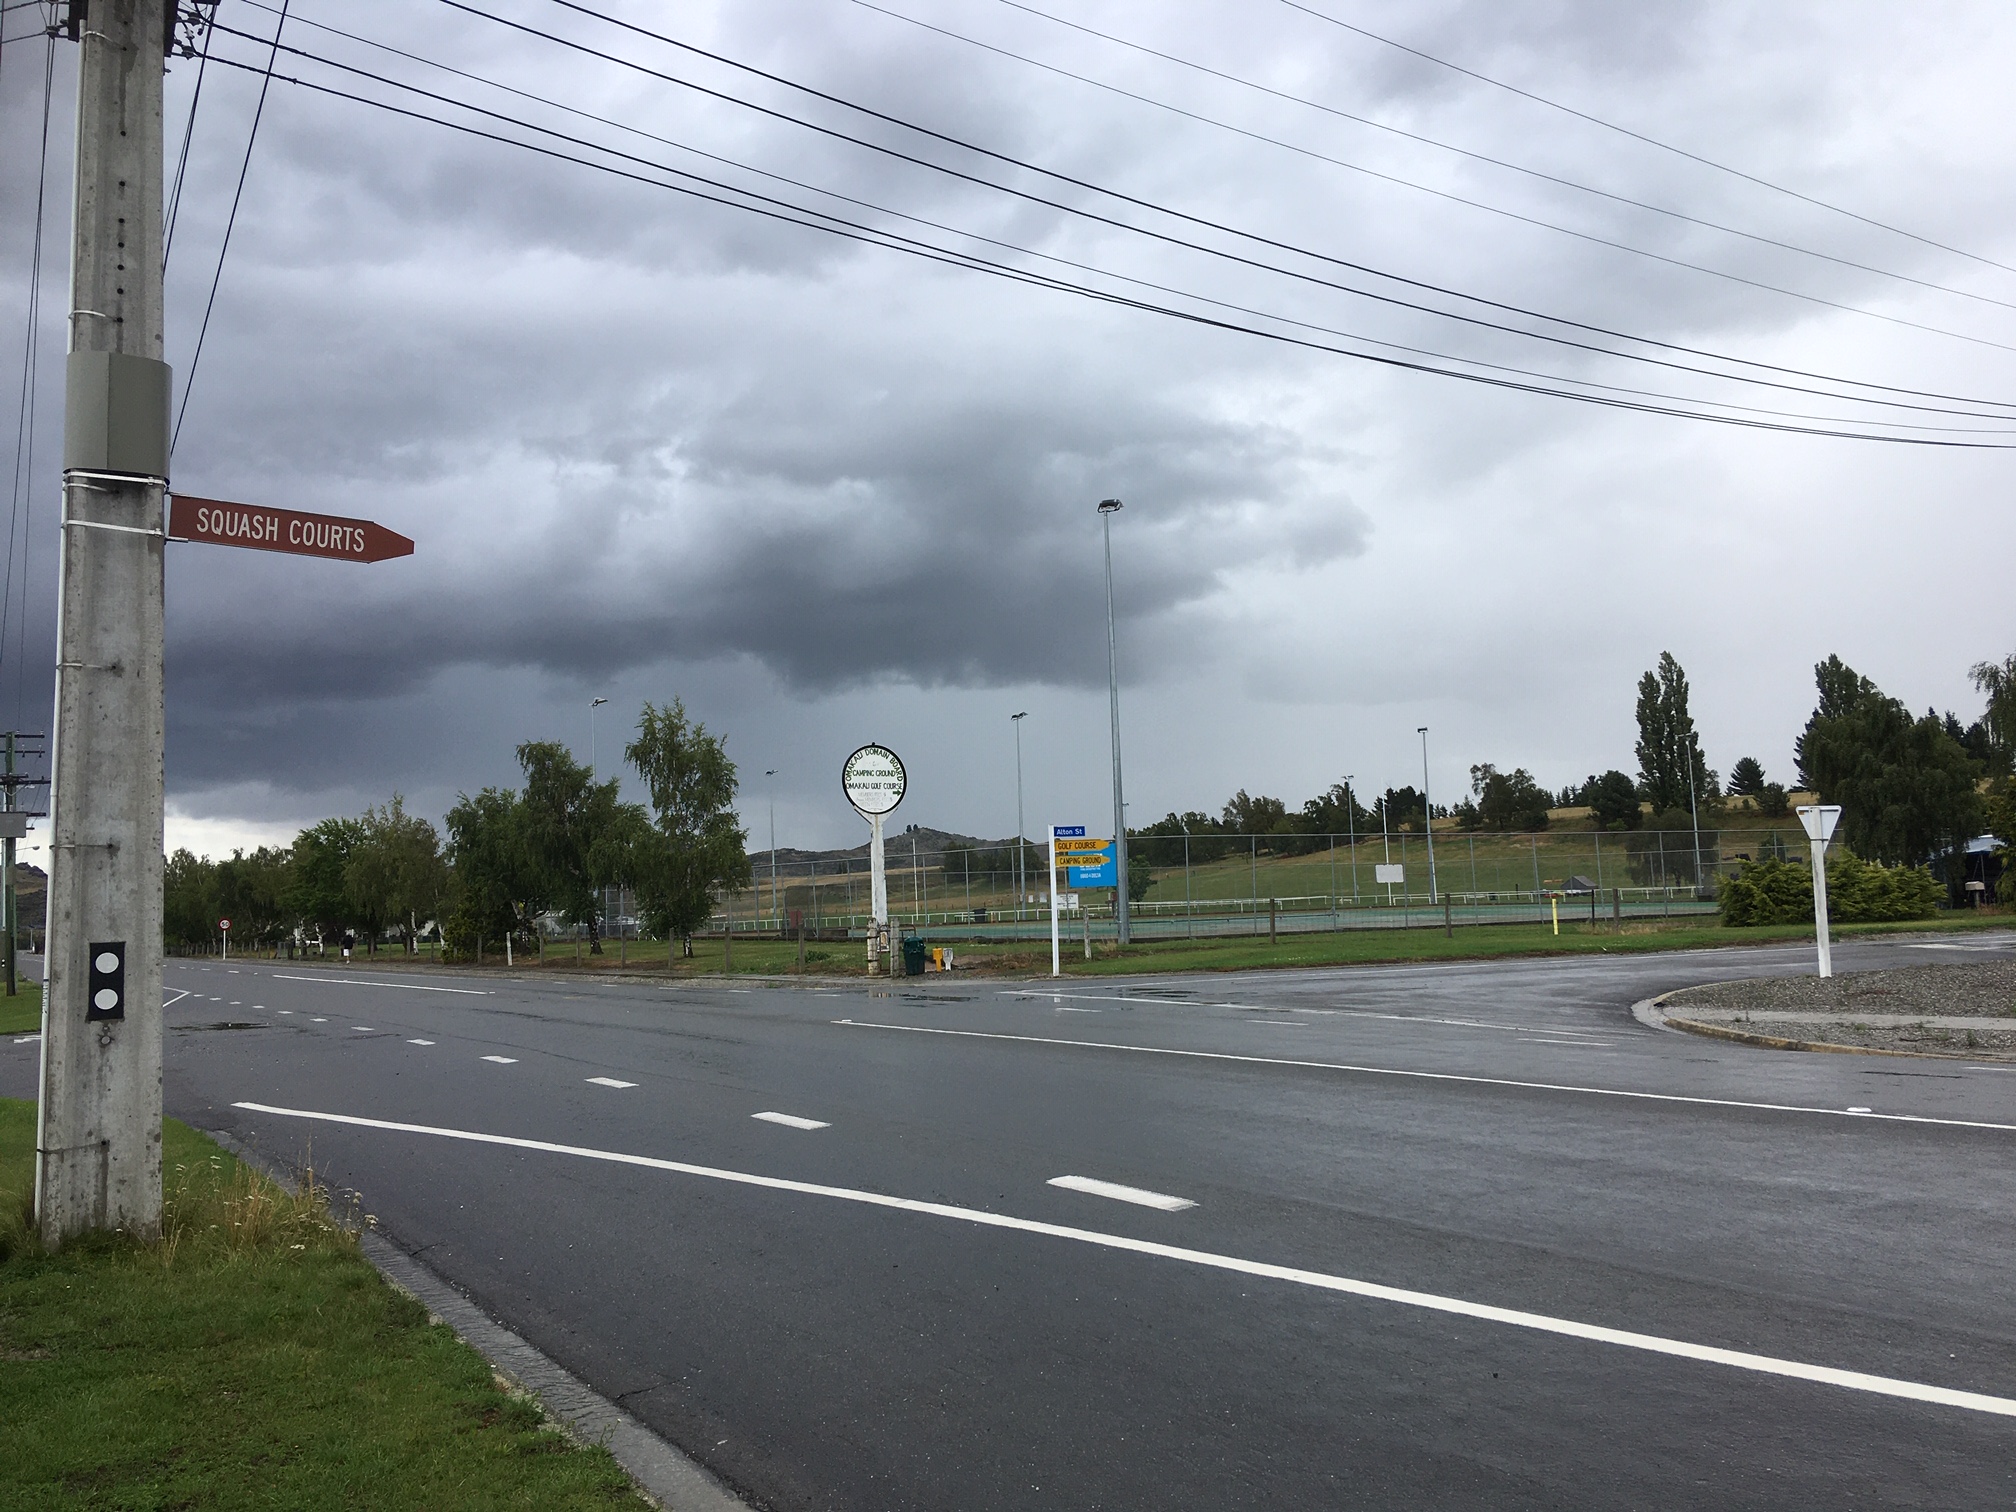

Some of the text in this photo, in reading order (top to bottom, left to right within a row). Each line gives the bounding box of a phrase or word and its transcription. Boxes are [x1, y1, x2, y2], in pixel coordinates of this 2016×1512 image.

[197, 507, 365, 553] SQUASH COURTS
[845, 748, 904, 782] OMAKAU DOMAIN BOARD
[846, 782, 903, 790] OMAKAU GOLF COURSE
[1056, 828, 1073, 836] Alton
[1058, 841, 1097, 850] GOLF COURSE
[1059, 856, 1102, 865] CAMPING GROUND
